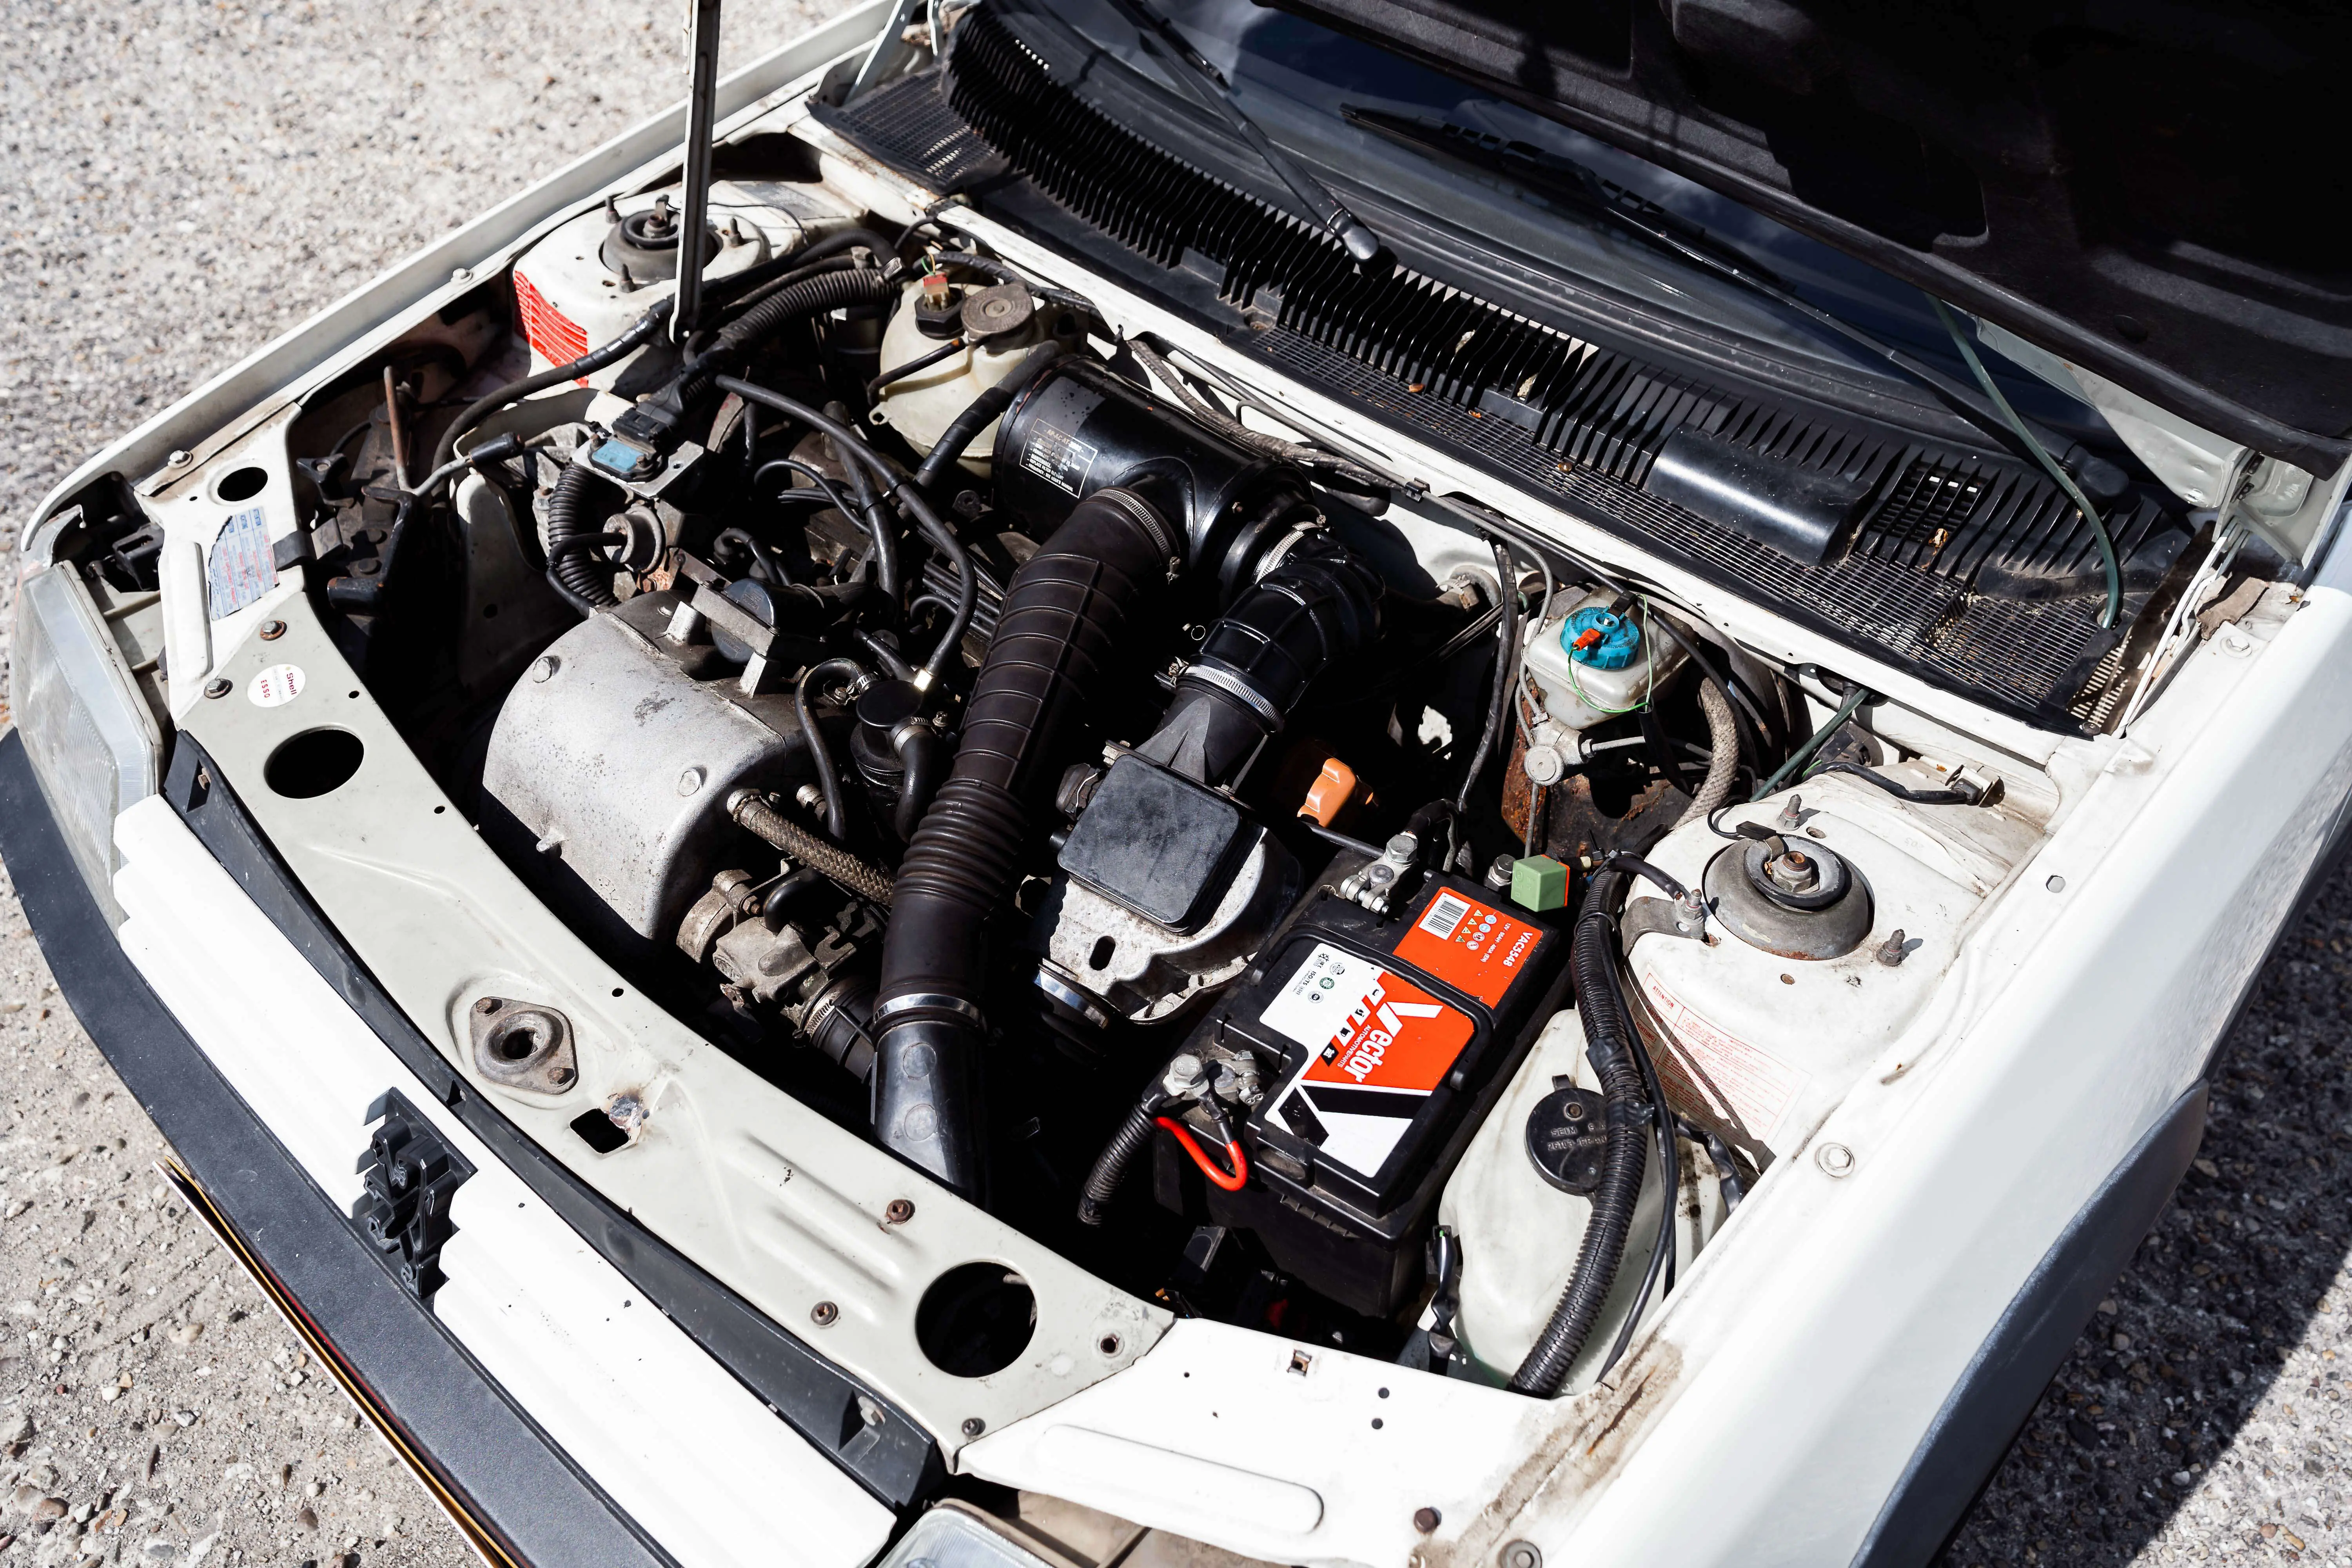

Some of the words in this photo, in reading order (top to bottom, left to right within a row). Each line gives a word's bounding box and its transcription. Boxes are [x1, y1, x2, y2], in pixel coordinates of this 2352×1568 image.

[260, 679, 270, 698] ESSO
[286, 673, 297, 695] Shell
[1502, 932, 1533, 967] VAC5548
[1302, 970, 1316, 986] ISO/TS
[1652, 985, 1675, 1008] ATTENTION
[1646, 1005, 1664, 1024] CAUTION
[1635, 1021, 1657, 1042] ACHTUNG!
[1337, 1024, 1372, 1068] AUTOMOTIVEPARTS
[1551, 1127, 1577, 1136] SEIM
